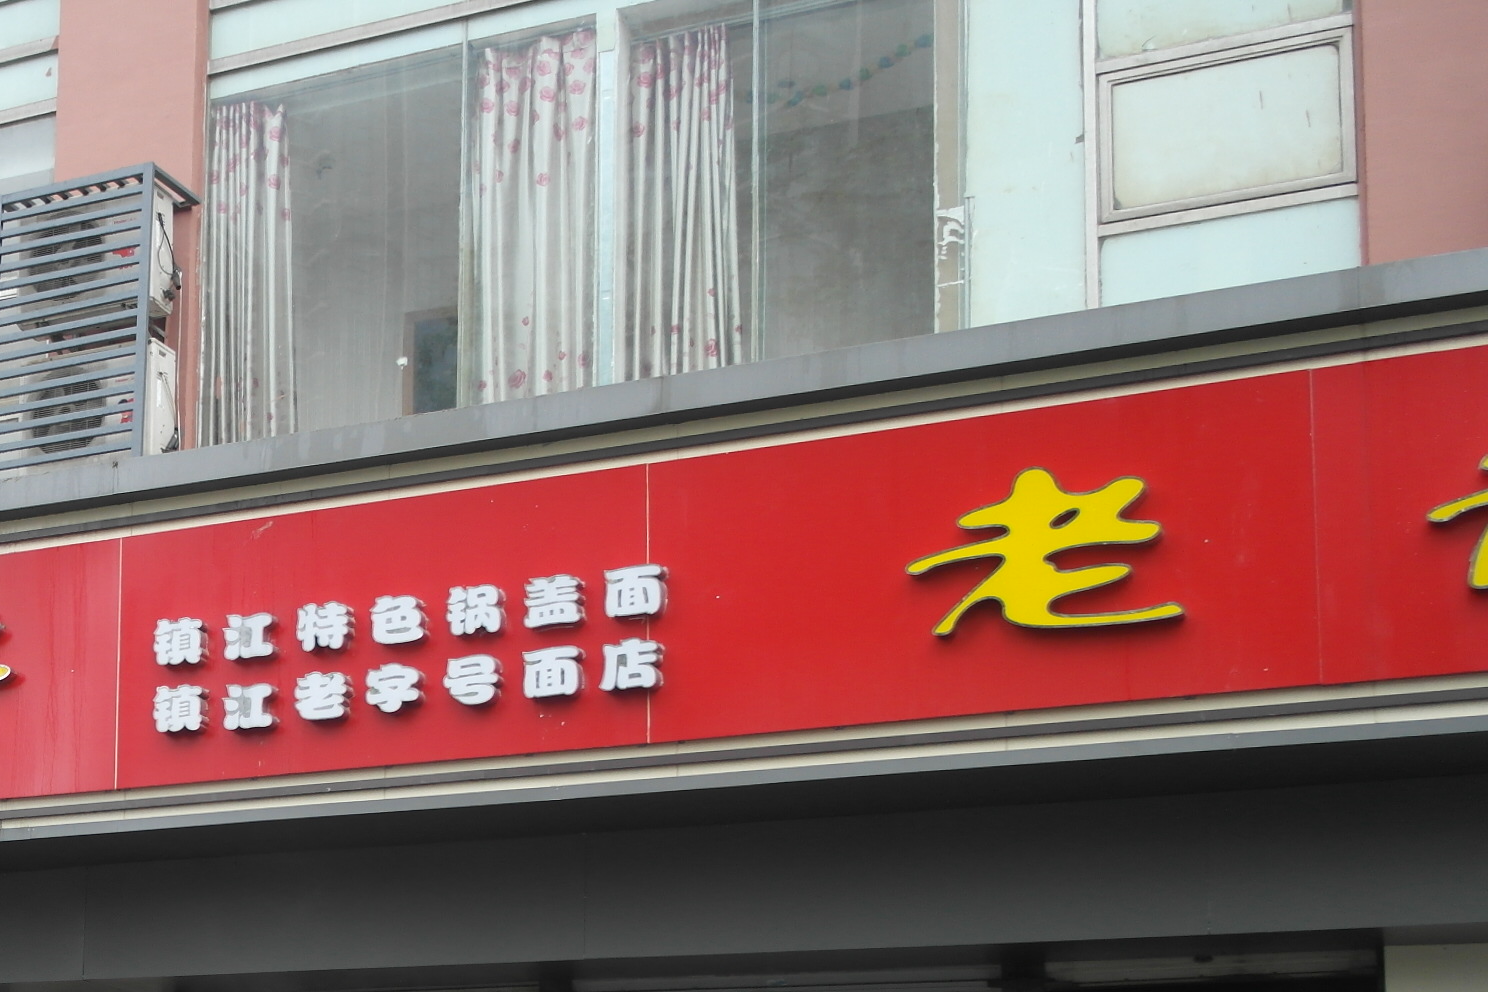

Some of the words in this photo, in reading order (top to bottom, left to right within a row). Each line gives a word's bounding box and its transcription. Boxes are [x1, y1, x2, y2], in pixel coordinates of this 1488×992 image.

[153, 563, 668, 667] 镇江特色锅盖面
[152, 637, 664, 734] 镇江老字号面店
